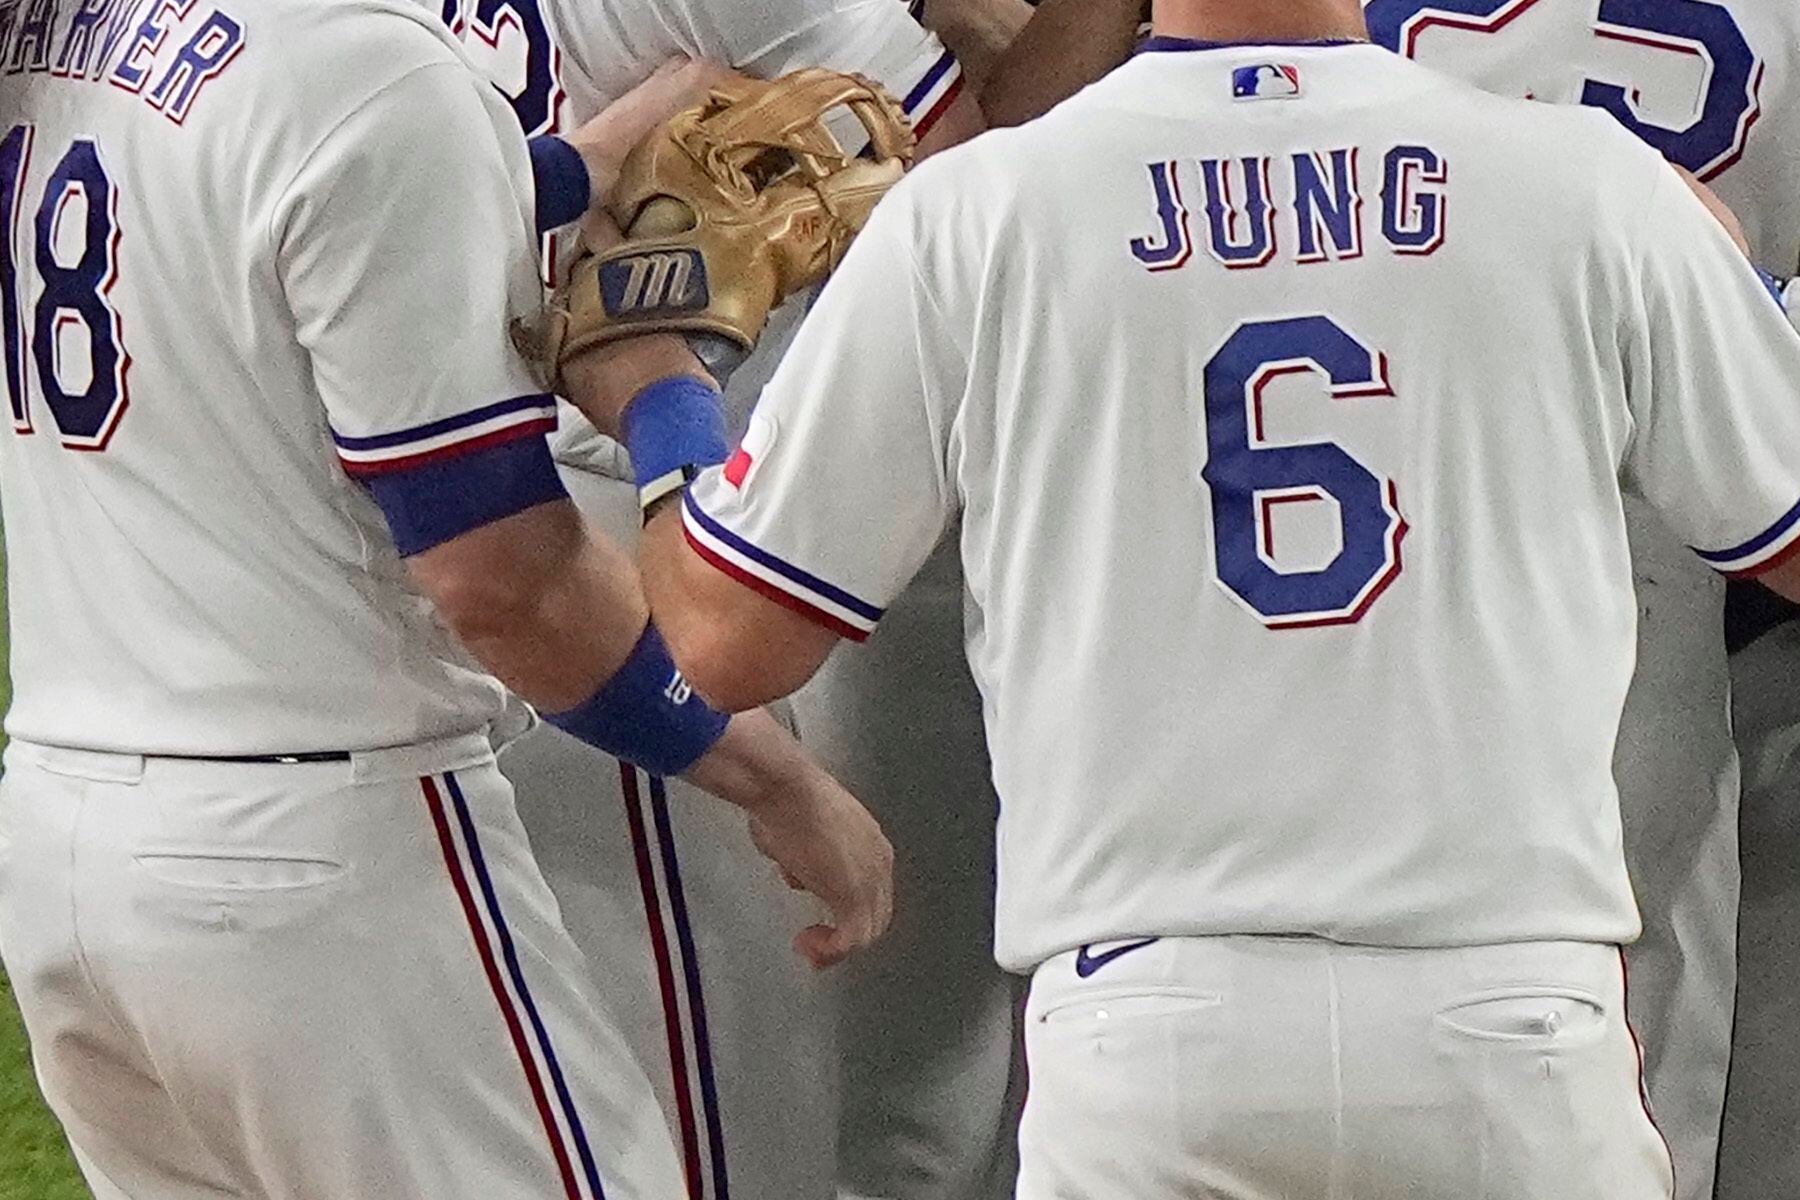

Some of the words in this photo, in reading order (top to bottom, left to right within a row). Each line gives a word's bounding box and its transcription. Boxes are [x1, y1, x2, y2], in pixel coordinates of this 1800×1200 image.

[0, 123, 133, 453] 18
[1130, 144, 1450, 273] JUNG
[1199, 313, 1412, 633] 6
